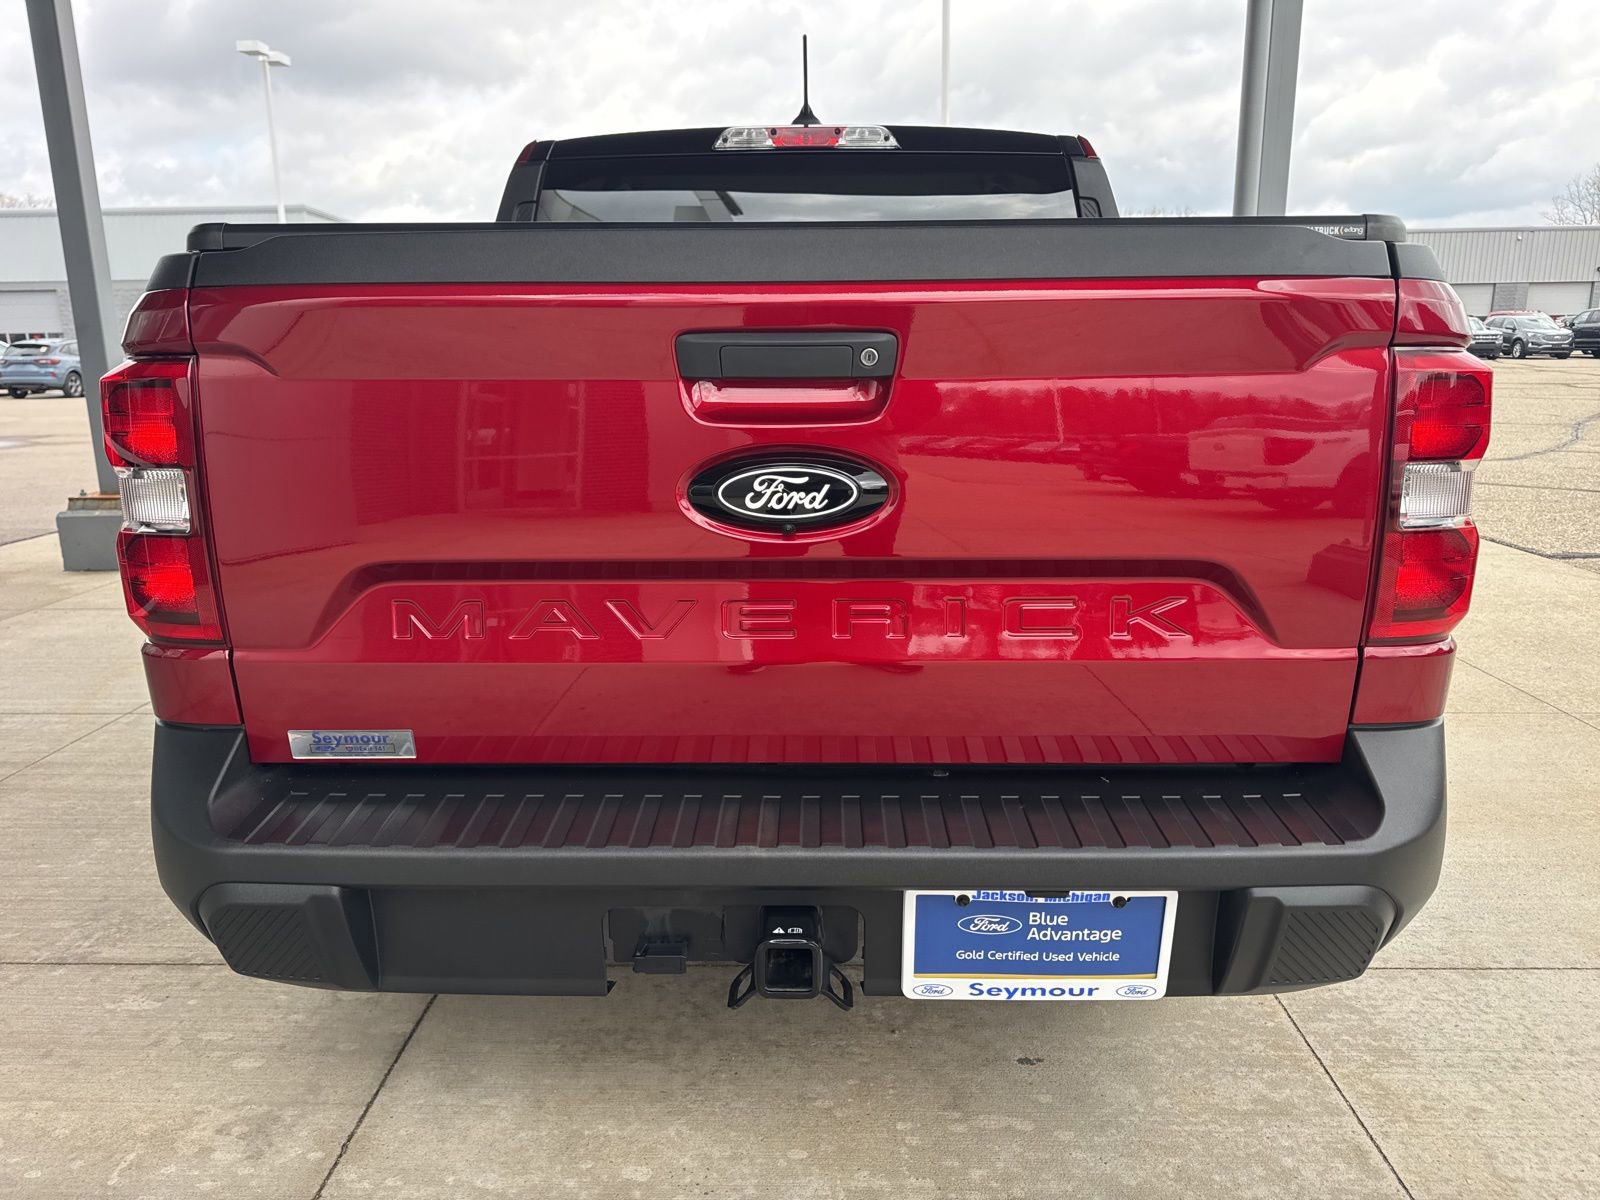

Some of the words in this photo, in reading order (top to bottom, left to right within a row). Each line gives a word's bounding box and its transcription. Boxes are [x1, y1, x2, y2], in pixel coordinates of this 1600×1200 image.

[744, 474, 831, 510] Ford
[391, 596, 1194, 640] MAVERICK
[312, 731, 389, 747] Seymour
[969, 917, 1011, 932] Ford
[1028, 912, 1069, 926] Blue
[1026, 927, 1122, 943] Advantage
[955, 950, 984, 960] Gold
[987, 950, 1039, 961] Certified
[1042, 951, 1074, 962] Used
[1077, 951, 1120, 962] Vehicle
[920, 985, 946, 995] Ford
[969, 982, 1100, 1000] Seymour
[1123, 986, 1149, 996] Ford
